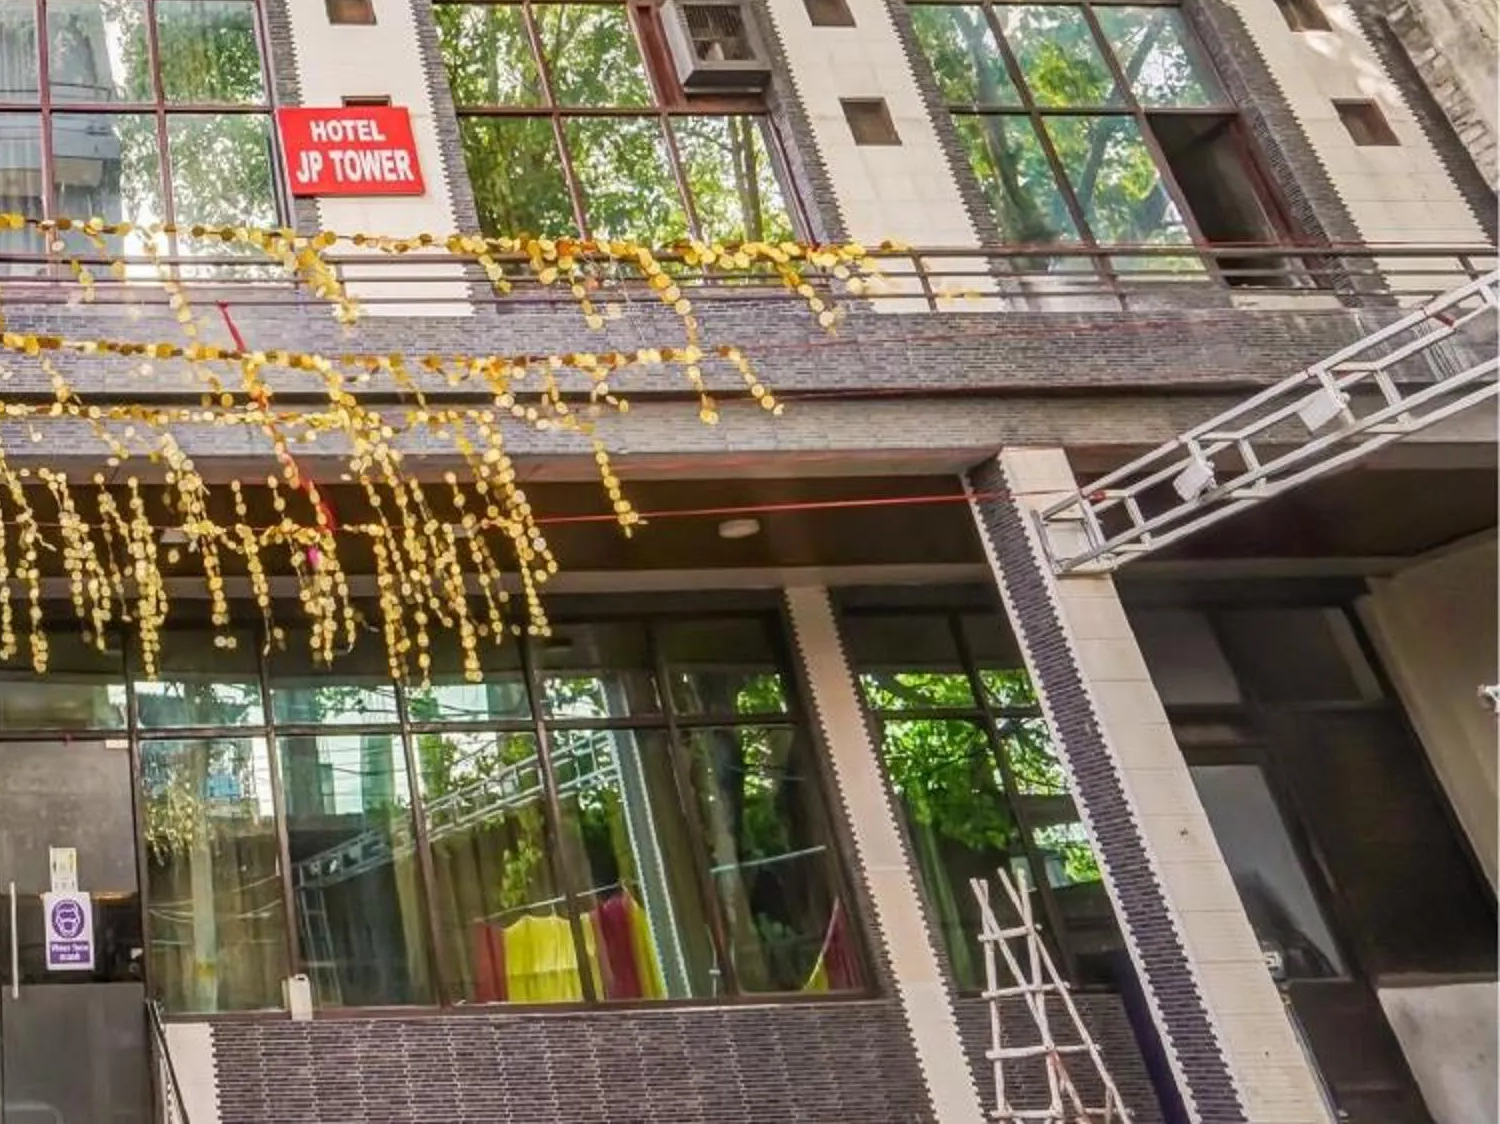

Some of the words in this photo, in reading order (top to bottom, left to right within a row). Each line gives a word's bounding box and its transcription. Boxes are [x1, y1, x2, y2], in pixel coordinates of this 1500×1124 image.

[309, 119, 386, 142] HOTEL
[296, 150, 323, 183] JP
[329, 149, 415, 182] TOWER
